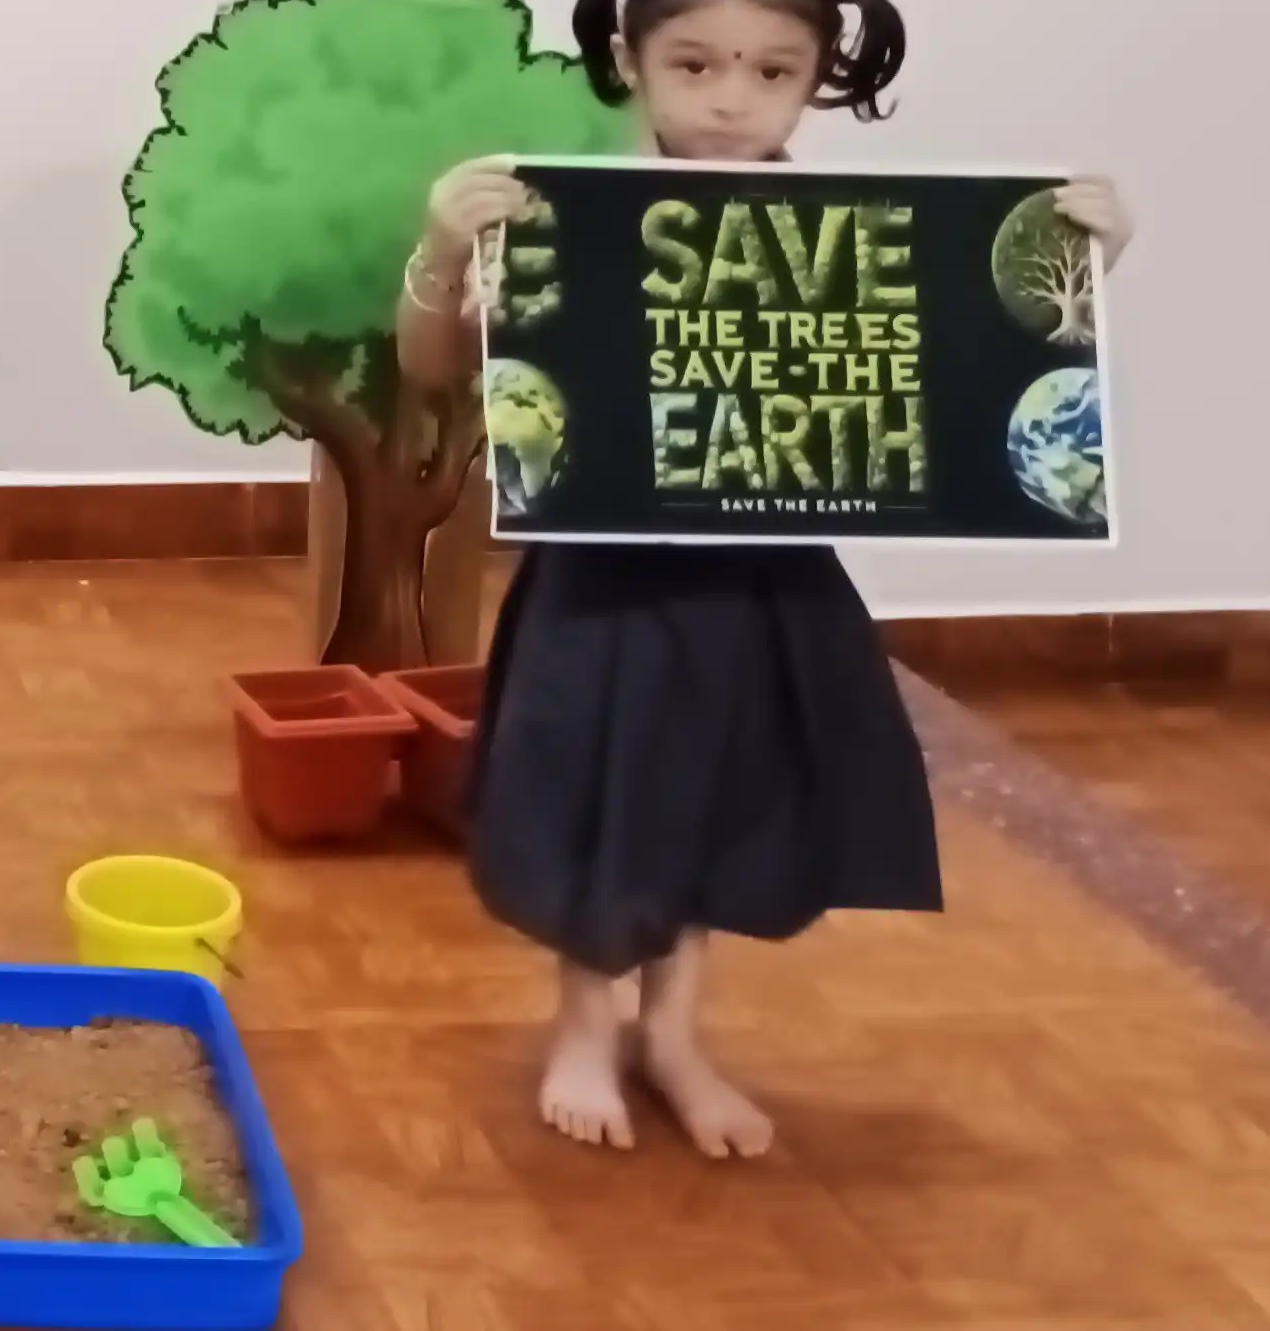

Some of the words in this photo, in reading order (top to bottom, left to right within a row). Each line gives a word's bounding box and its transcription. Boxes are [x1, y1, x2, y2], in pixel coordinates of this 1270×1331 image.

[640, 196, 919, 308] SAVE
[645, 308, 744, 348] THE
[757, 310, 922, 352] TREES
[649, 350, 779, 389] SAVE
[808, 352, 921, 391] THE
[649, 392, 926, 493] EARTH
[720, 497, 766, 513] SAVE
[774, 497, 808, 513] THE
[815, 498, 877, 513] EARTH
